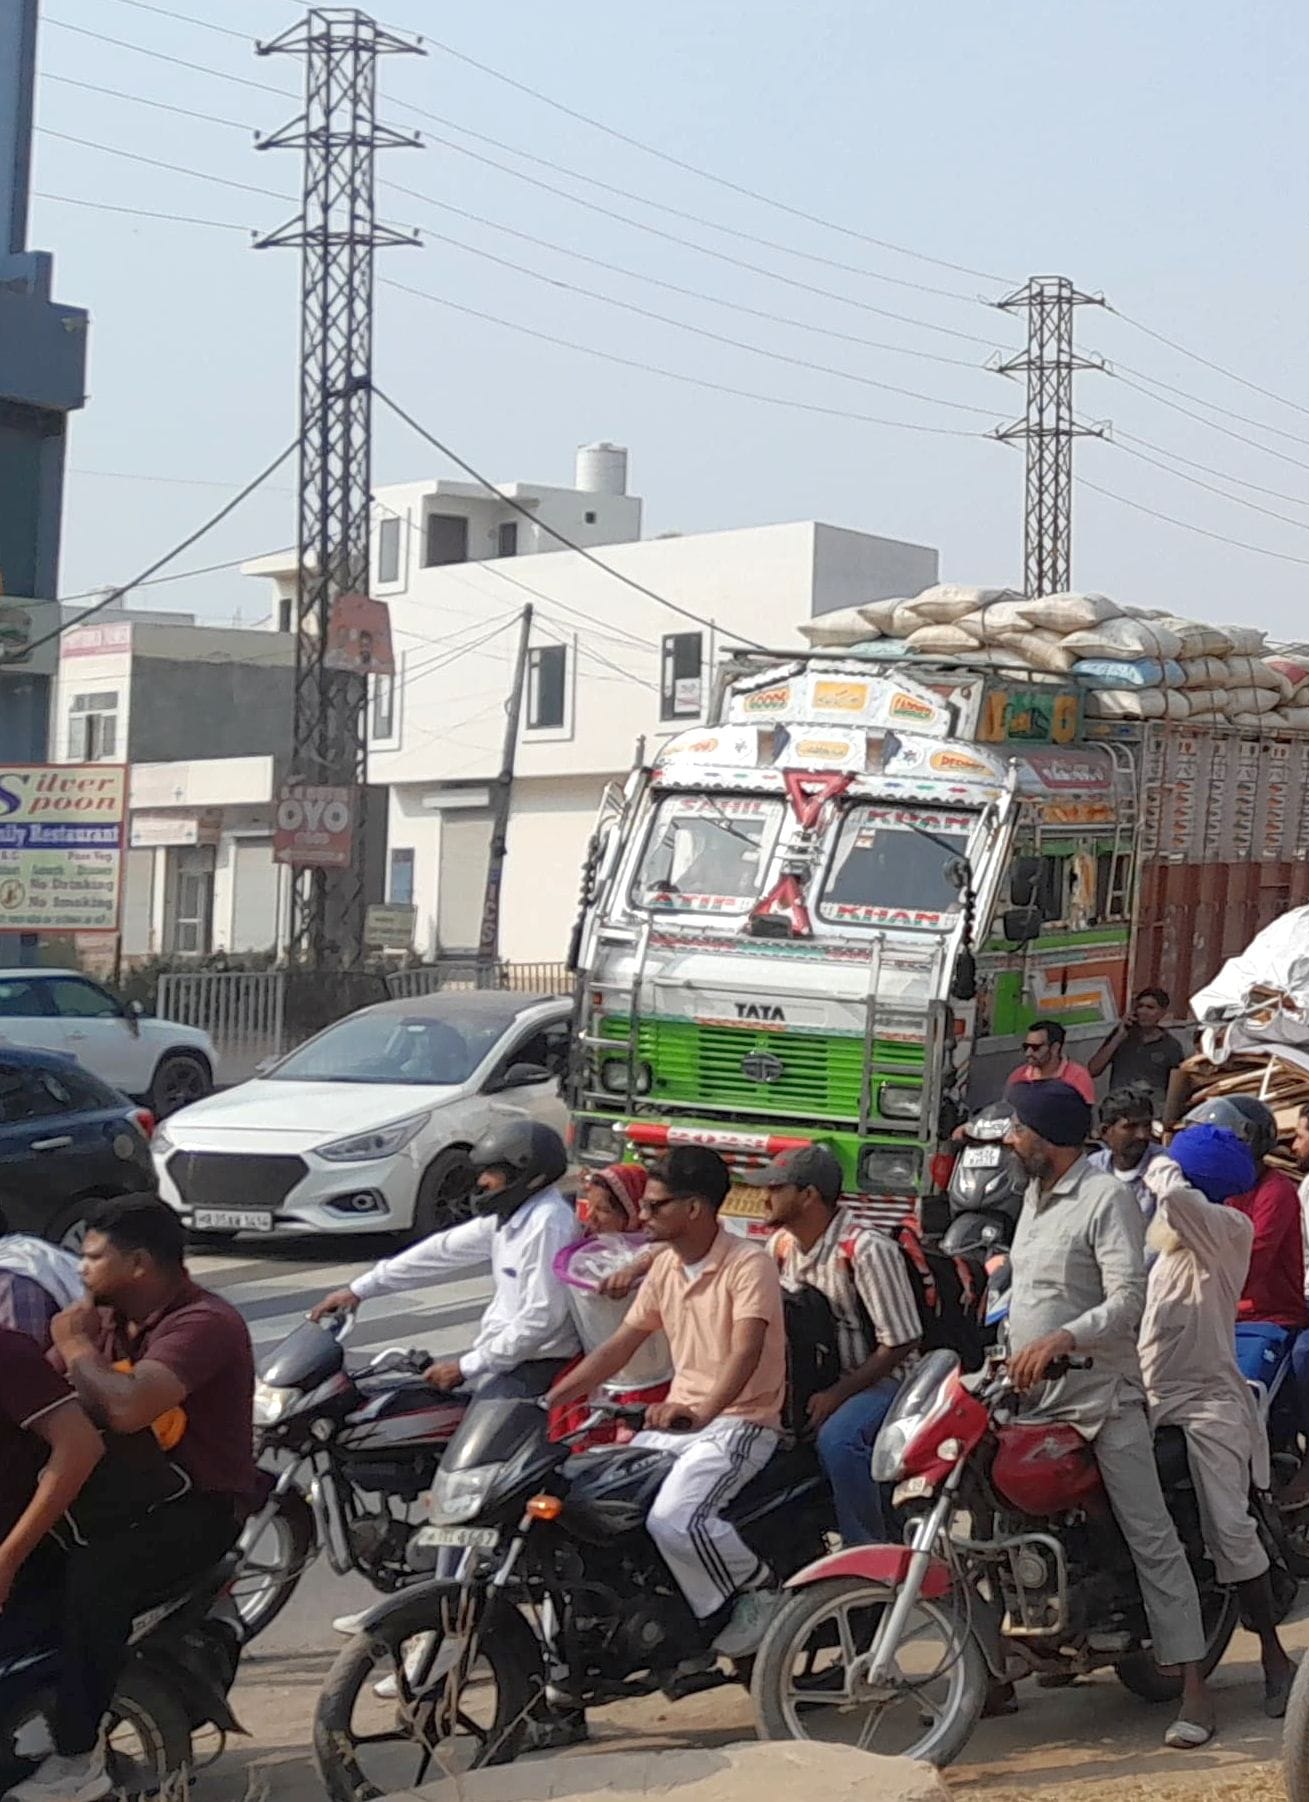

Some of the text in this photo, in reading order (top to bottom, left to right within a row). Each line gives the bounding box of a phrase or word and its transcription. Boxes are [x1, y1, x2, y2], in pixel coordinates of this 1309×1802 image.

[277, 800, 349, 834] OYO
[835, 904, 942, 927] KHAN
[734, 1002, 787, 1022] TATA
